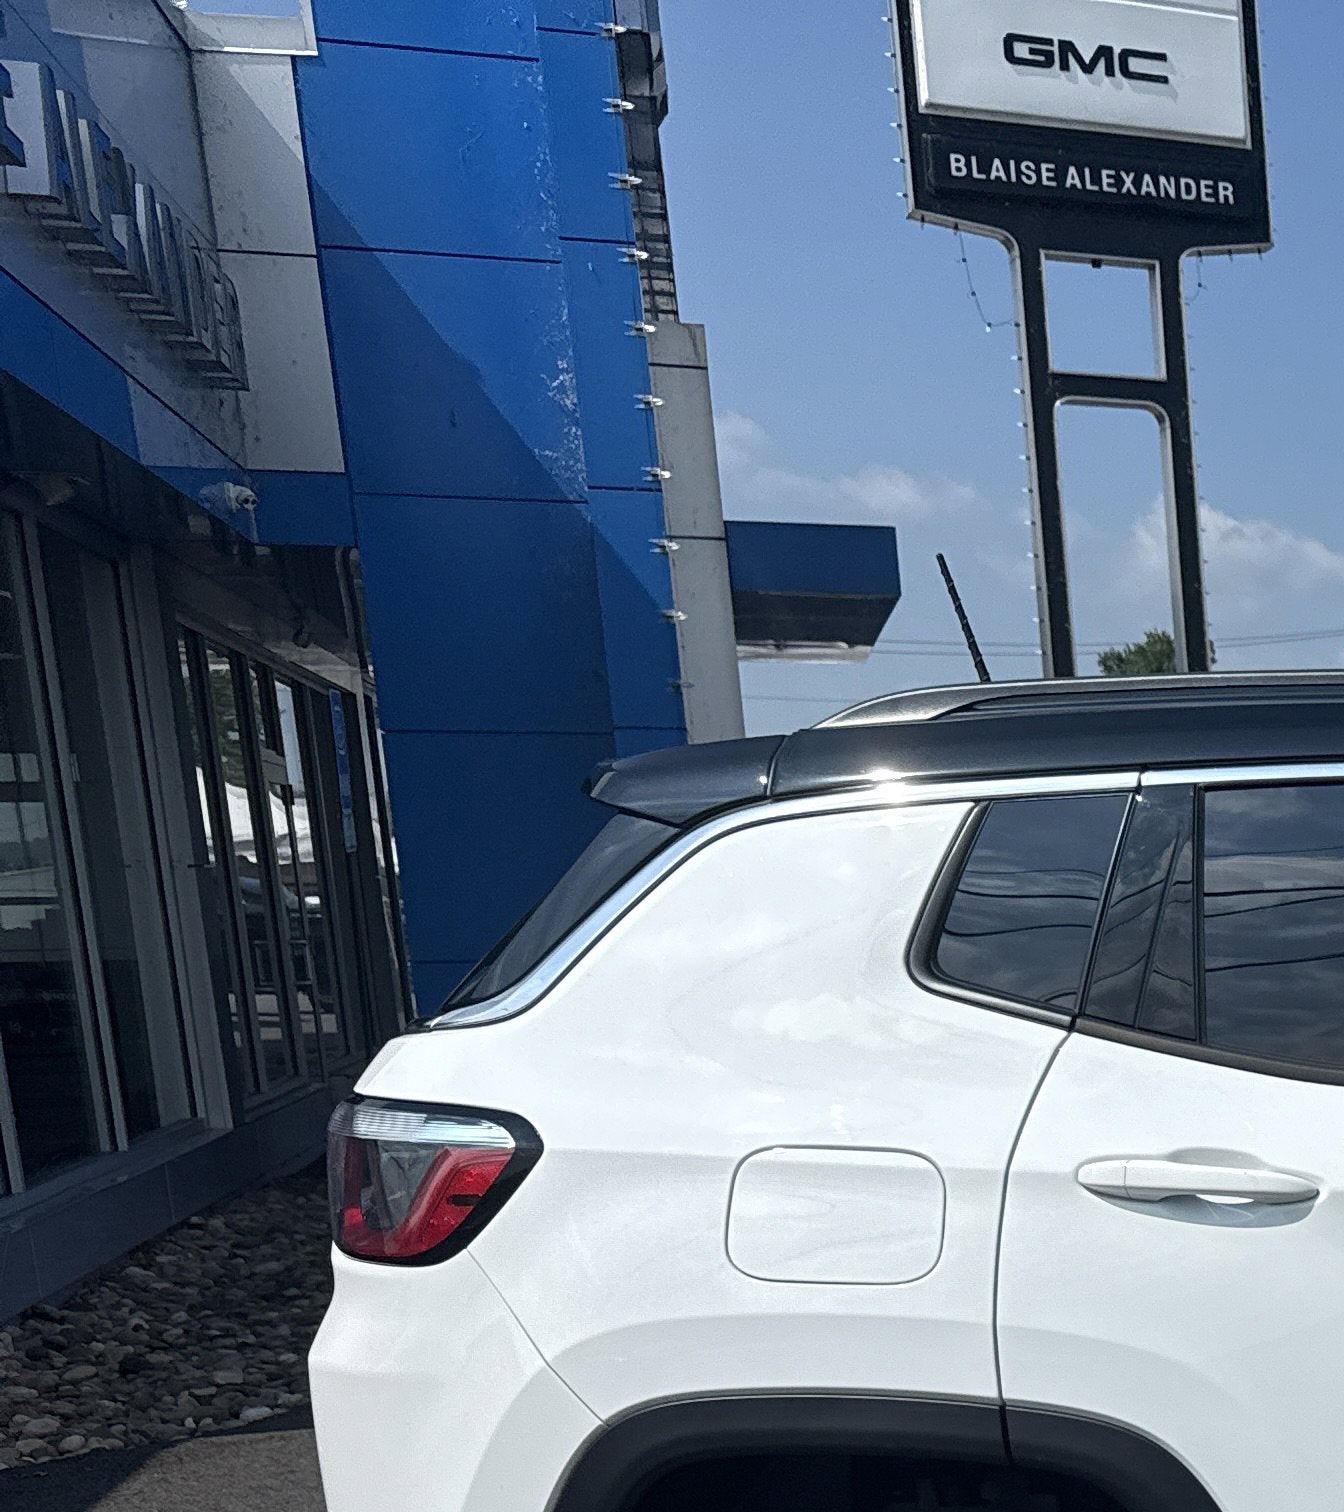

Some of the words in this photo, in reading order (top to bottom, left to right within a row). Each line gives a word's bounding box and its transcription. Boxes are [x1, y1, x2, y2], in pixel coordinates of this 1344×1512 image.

[1003, 33, 1169, 84] GMC
[949, 153, 1058, 187] BLAISE
[1065, 166, 1236, 205] ALEXANDER
